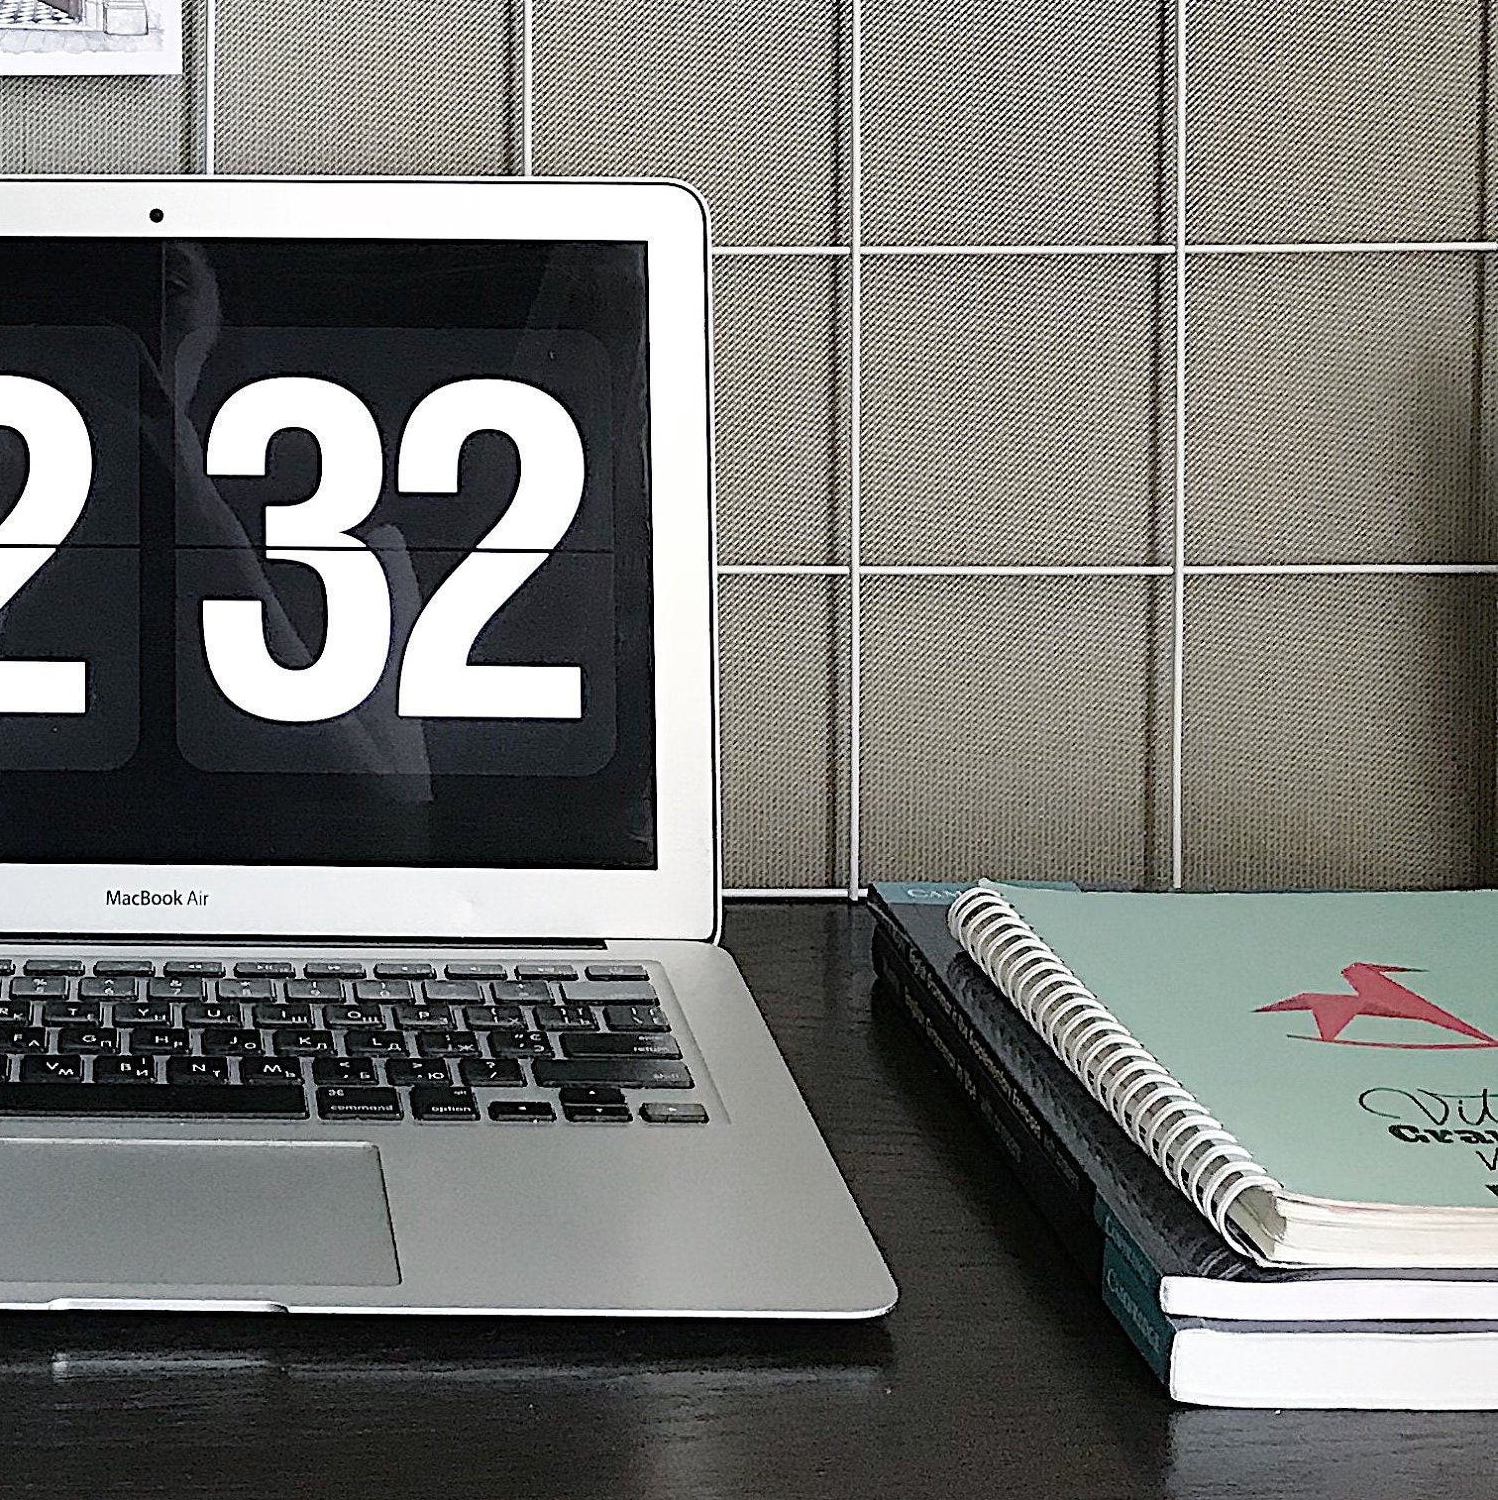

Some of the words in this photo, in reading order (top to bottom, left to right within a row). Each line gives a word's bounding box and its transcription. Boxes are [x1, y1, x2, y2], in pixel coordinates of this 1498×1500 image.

[202, 376, 585, 723] 32
[106, 890, 183, 906] MacBook
[187, 890, 209, 906] Air
[67, 1007, 78, 1016] T
[138, 1008, 149, 1016] Y
[207, 1008, 221, 1017] U
[82, 1035, 97, 1043] G
[229, 1036, 238, 1044] J
[299, 1037, 311, 1045] K
[372, 1038, 382, 1046] L
[46, 1062, 59, 1070] V
[192, 1064, 206, 1072] N
[263, 1065, 282, 1073] M
[431, 1105, 472, 1113] option
